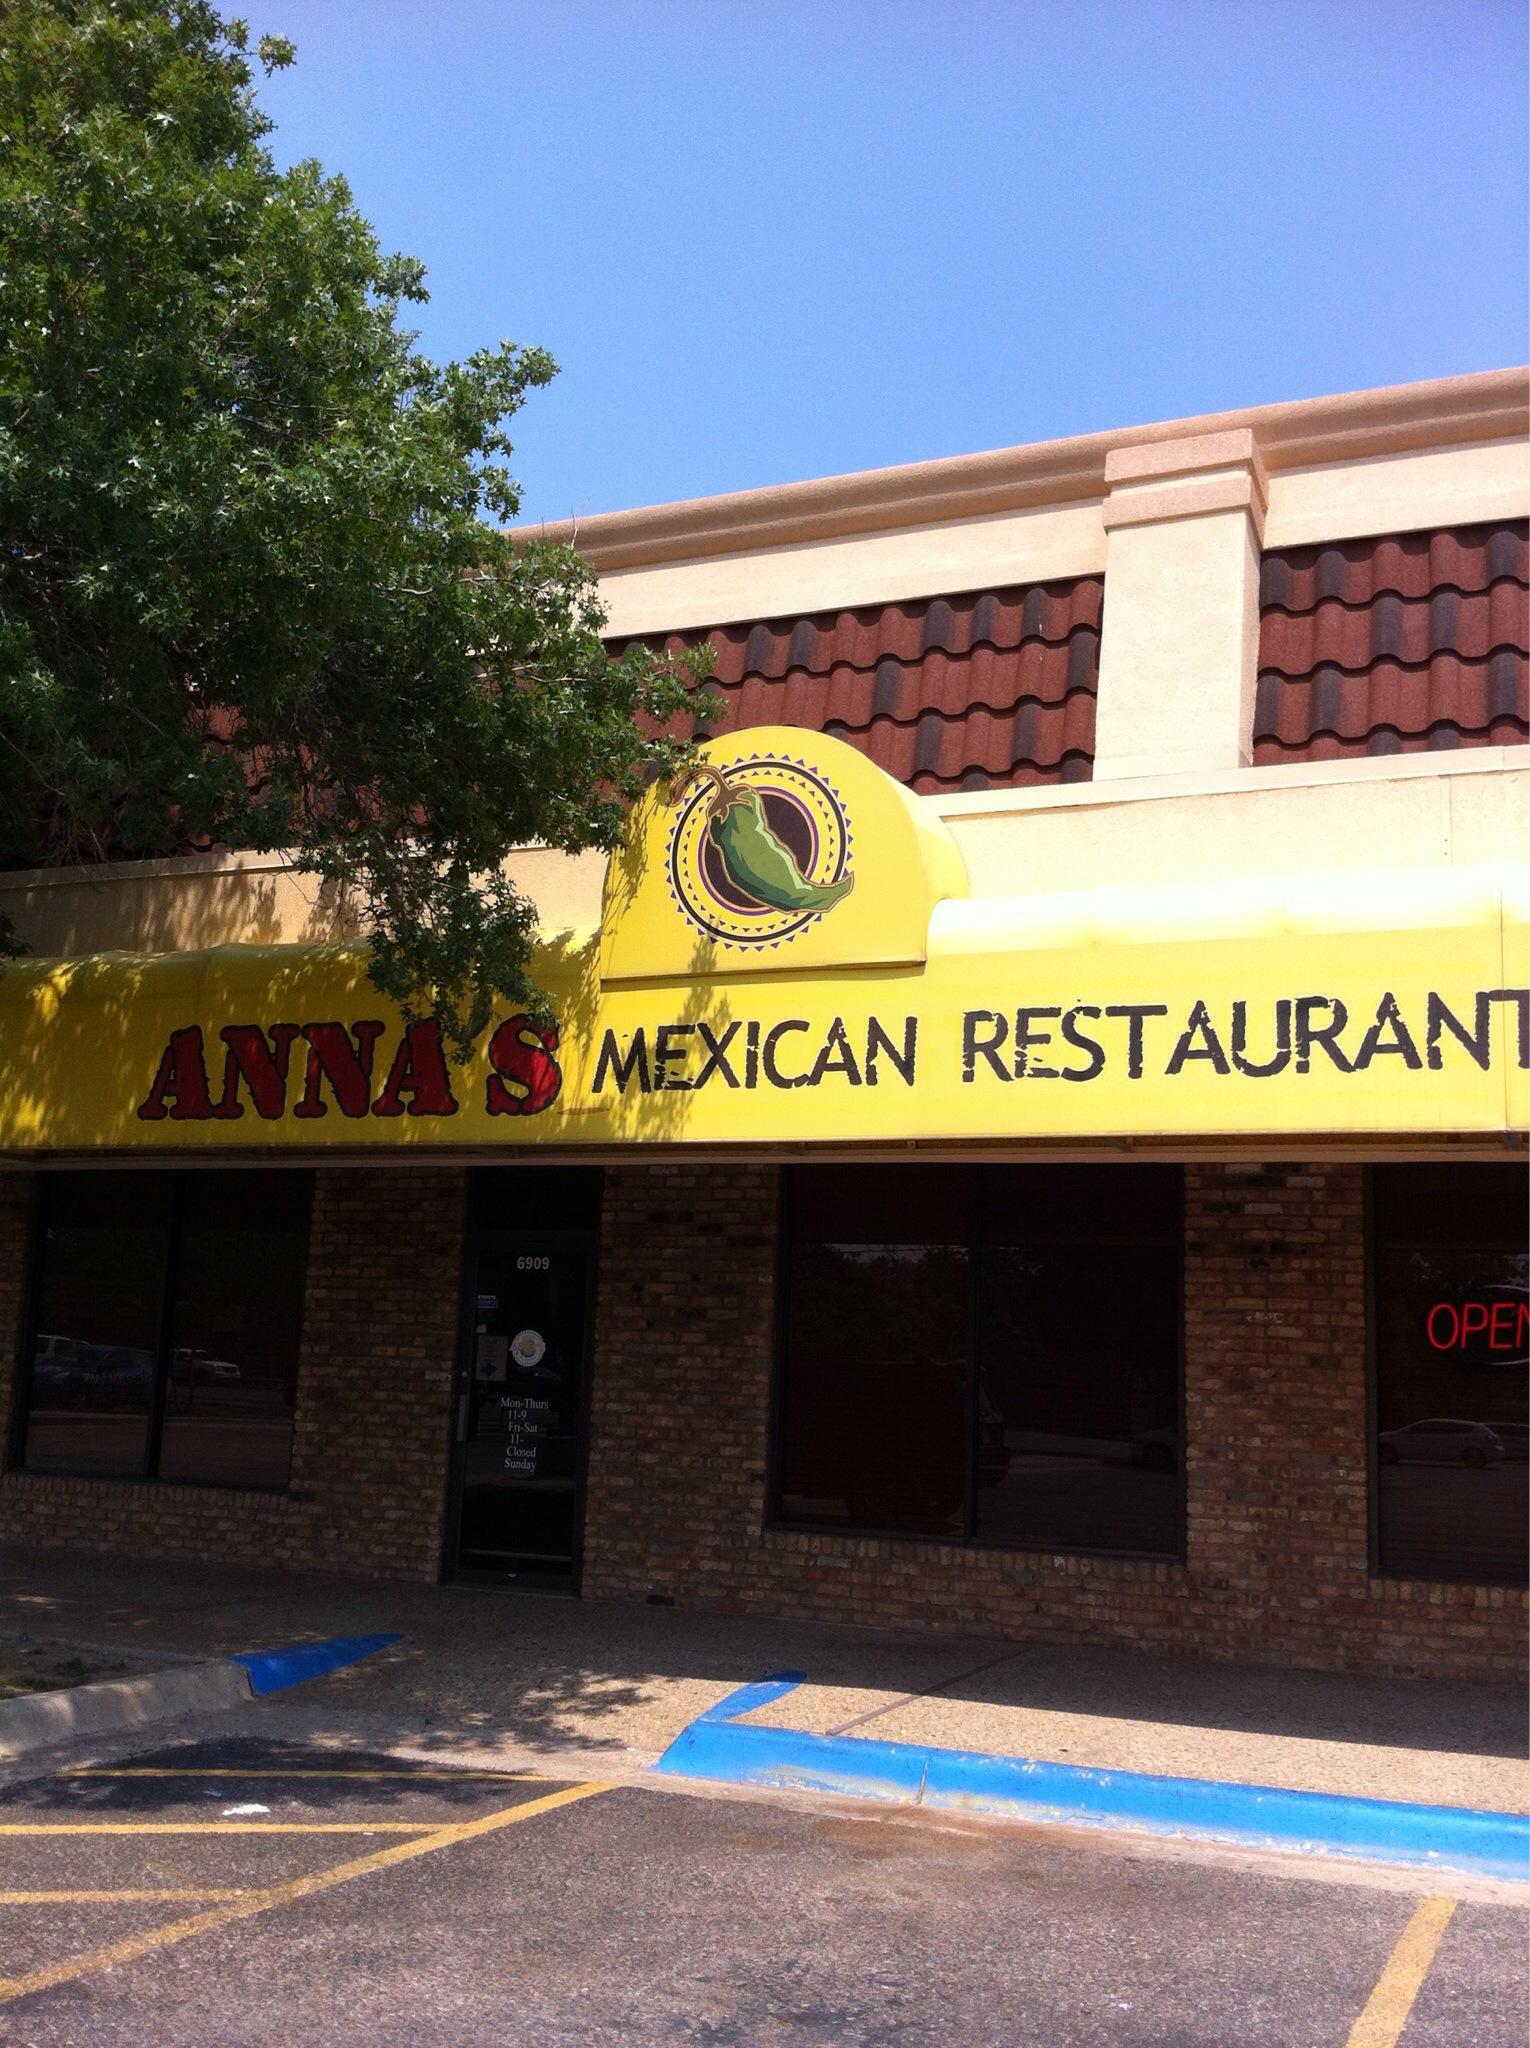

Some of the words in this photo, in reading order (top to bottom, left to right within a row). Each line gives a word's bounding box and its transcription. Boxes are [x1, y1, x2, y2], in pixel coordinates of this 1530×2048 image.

[592, 1015, 919, 1094] MEXICAN
[962, 988, 1530, 1082] RESTAURANT
[516, 1256, 550, 1270] 6909
[500, 1397, 549, 1409] Mon-Thurs
[508, 1409, 527, 1420] 11-9
[508, 1421, 538, 1433] Fri-Sat
[506, 1446, 536, 1458] Closed
[504, 1458, 536, 1472] Sunday
